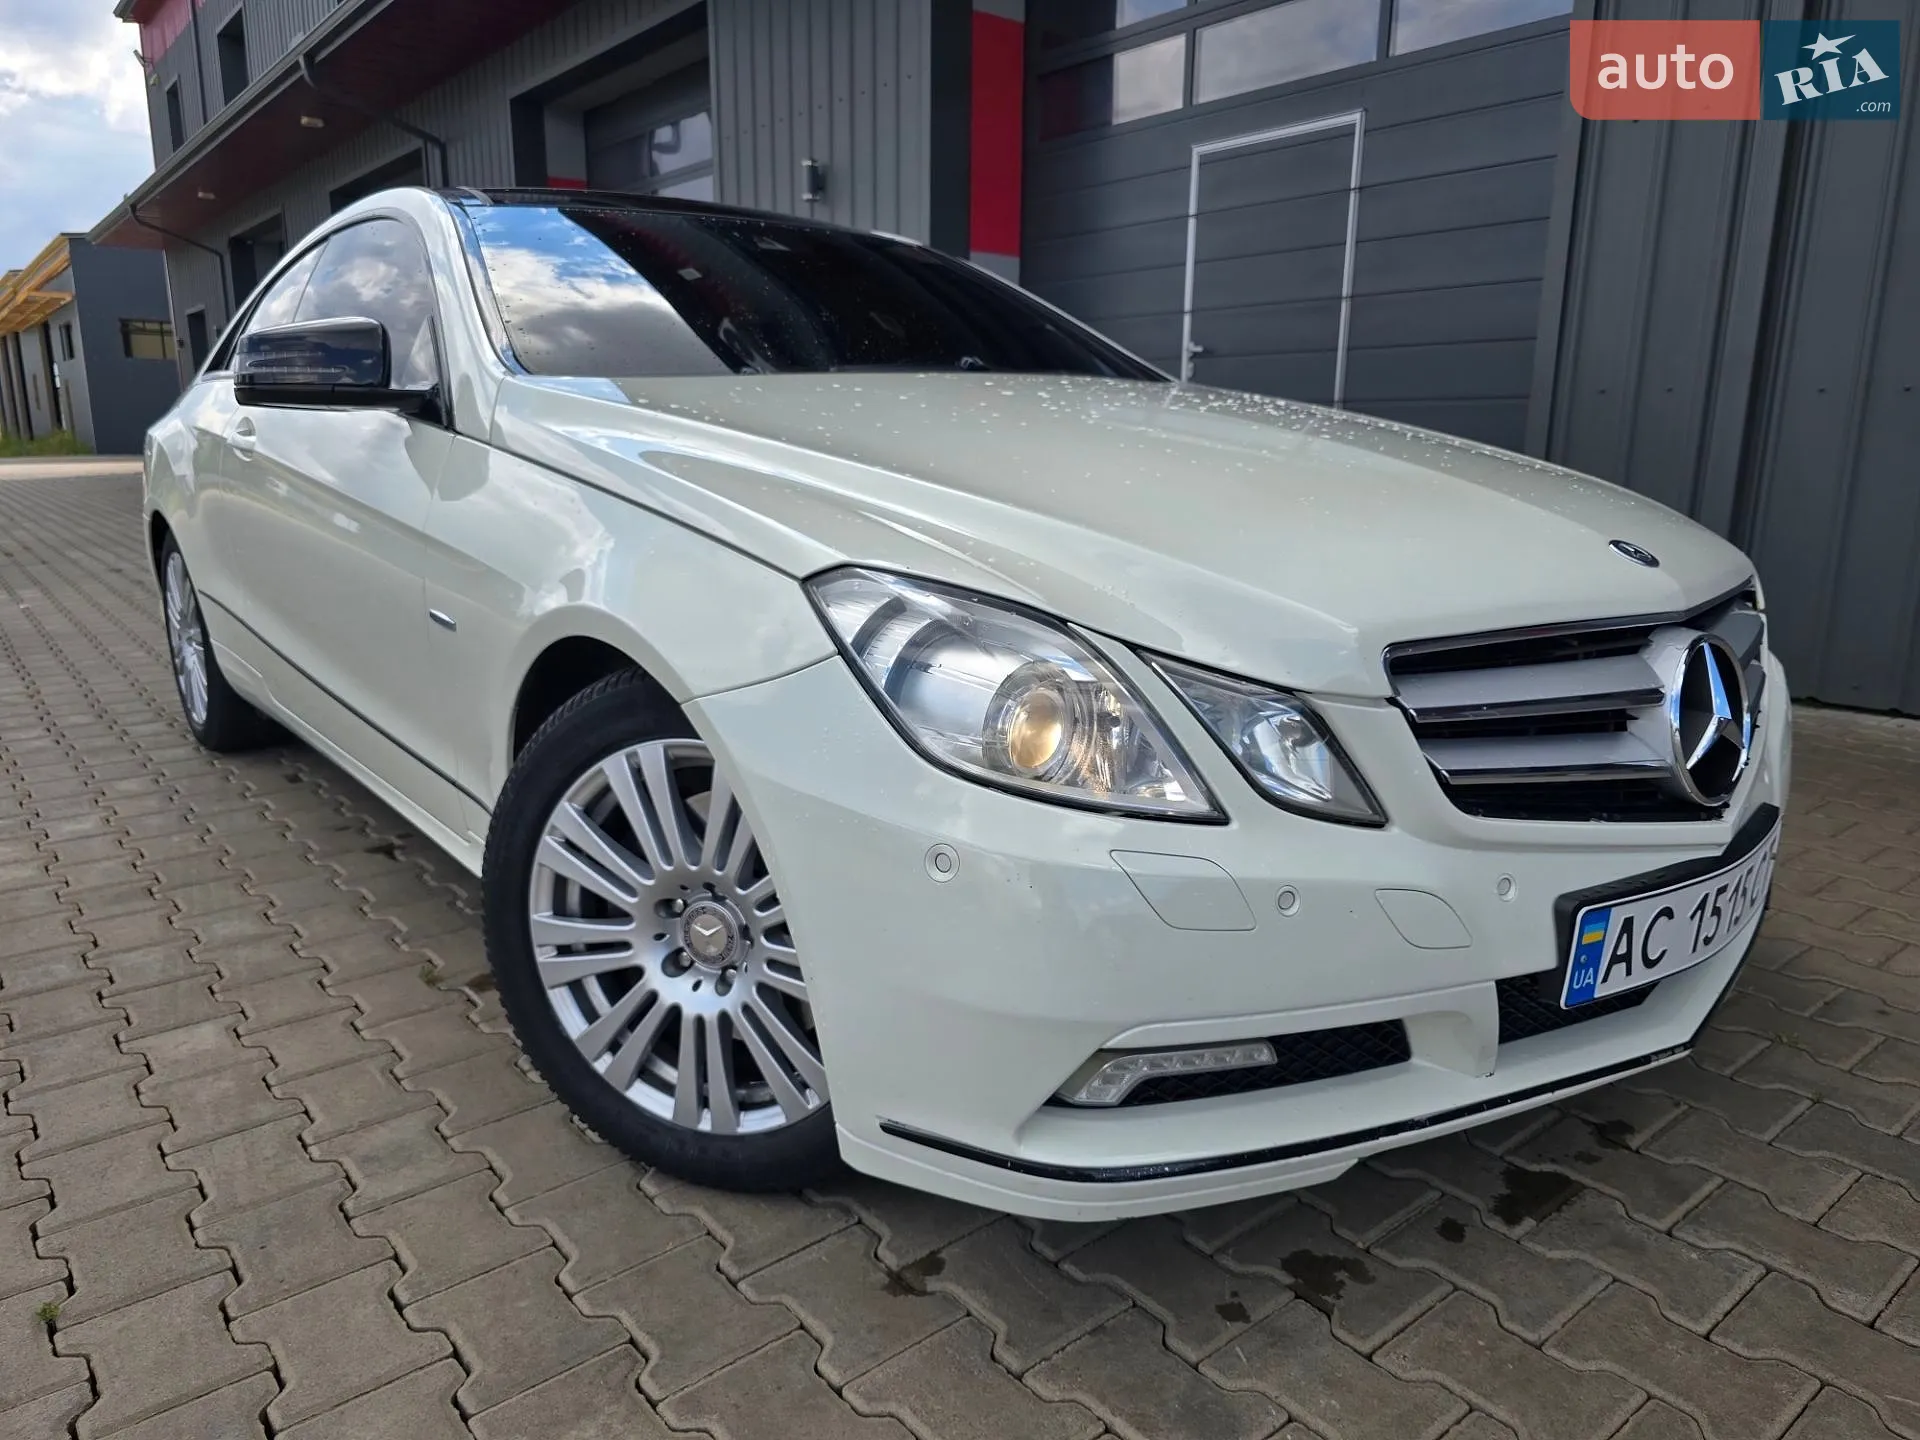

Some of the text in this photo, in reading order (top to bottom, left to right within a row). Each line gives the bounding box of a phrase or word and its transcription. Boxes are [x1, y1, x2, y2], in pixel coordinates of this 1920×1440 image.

[1601, 906, 1675, 984] AC
[1689, 865, 1753, 954] 1515
[1572, 967, 1595, 990] UA
